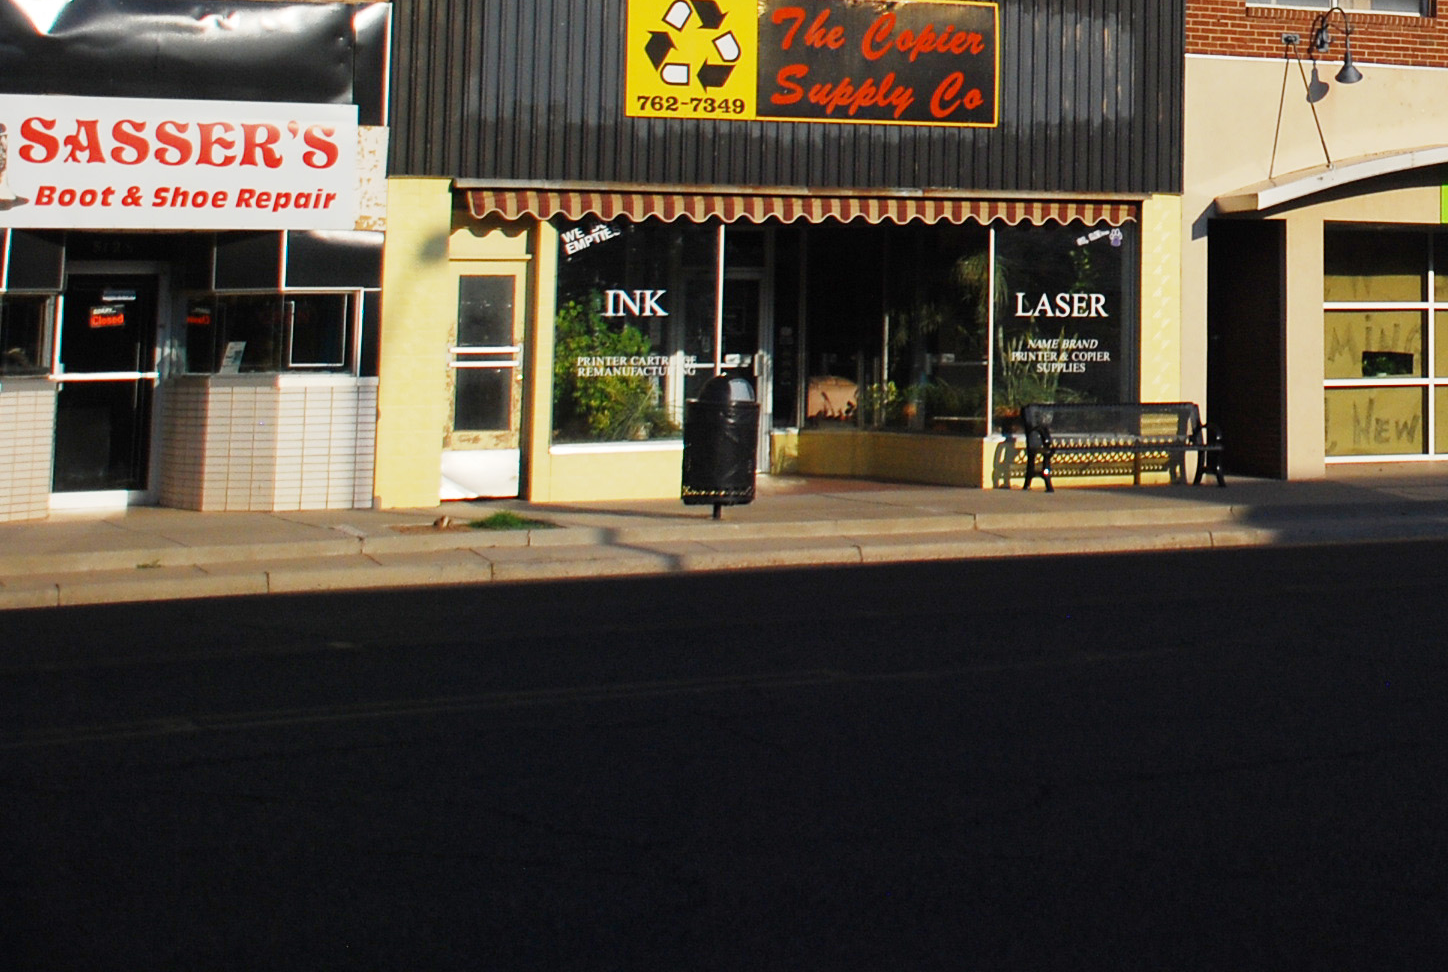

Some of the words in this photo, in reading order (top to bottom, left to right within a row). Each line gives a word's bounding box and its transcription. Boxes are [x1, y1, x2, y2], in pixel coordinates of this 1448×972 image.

[770, 6, 846, 51] The
[861, 12, 985, 62] Copier
[770, 63, 915, 119] Supply
[929, 71, 984, 119] Co
[636, 95, 746, 115] 762-7349
[18, 116, 340, 170] SASSER'S
[34, 185, 115, 208] Boot
[121, 185, 143, 208] &
[151, 186, 229, 209] Shoe
[235, 188, 337, 213] Repair
[562, 227, 585, 243] WE
[600, 289, 669, 317] INK
[1014, 291, 1109, 318] LASER
[1027, 338, 1059, 349] NAME
[1061, 338, 1099, 349] BRAND
[577, 355, 630, 367] PRINTER
[630, 355, 698, 367] CARTRGE
[1011, 351, 1051, 362] PRINTER
[1071, 351, 1111, 362] COPIER
[577, 366, 697, 378] REMANUFACTUNG
[1036, 362, 1086, 373] SUPPLIES
